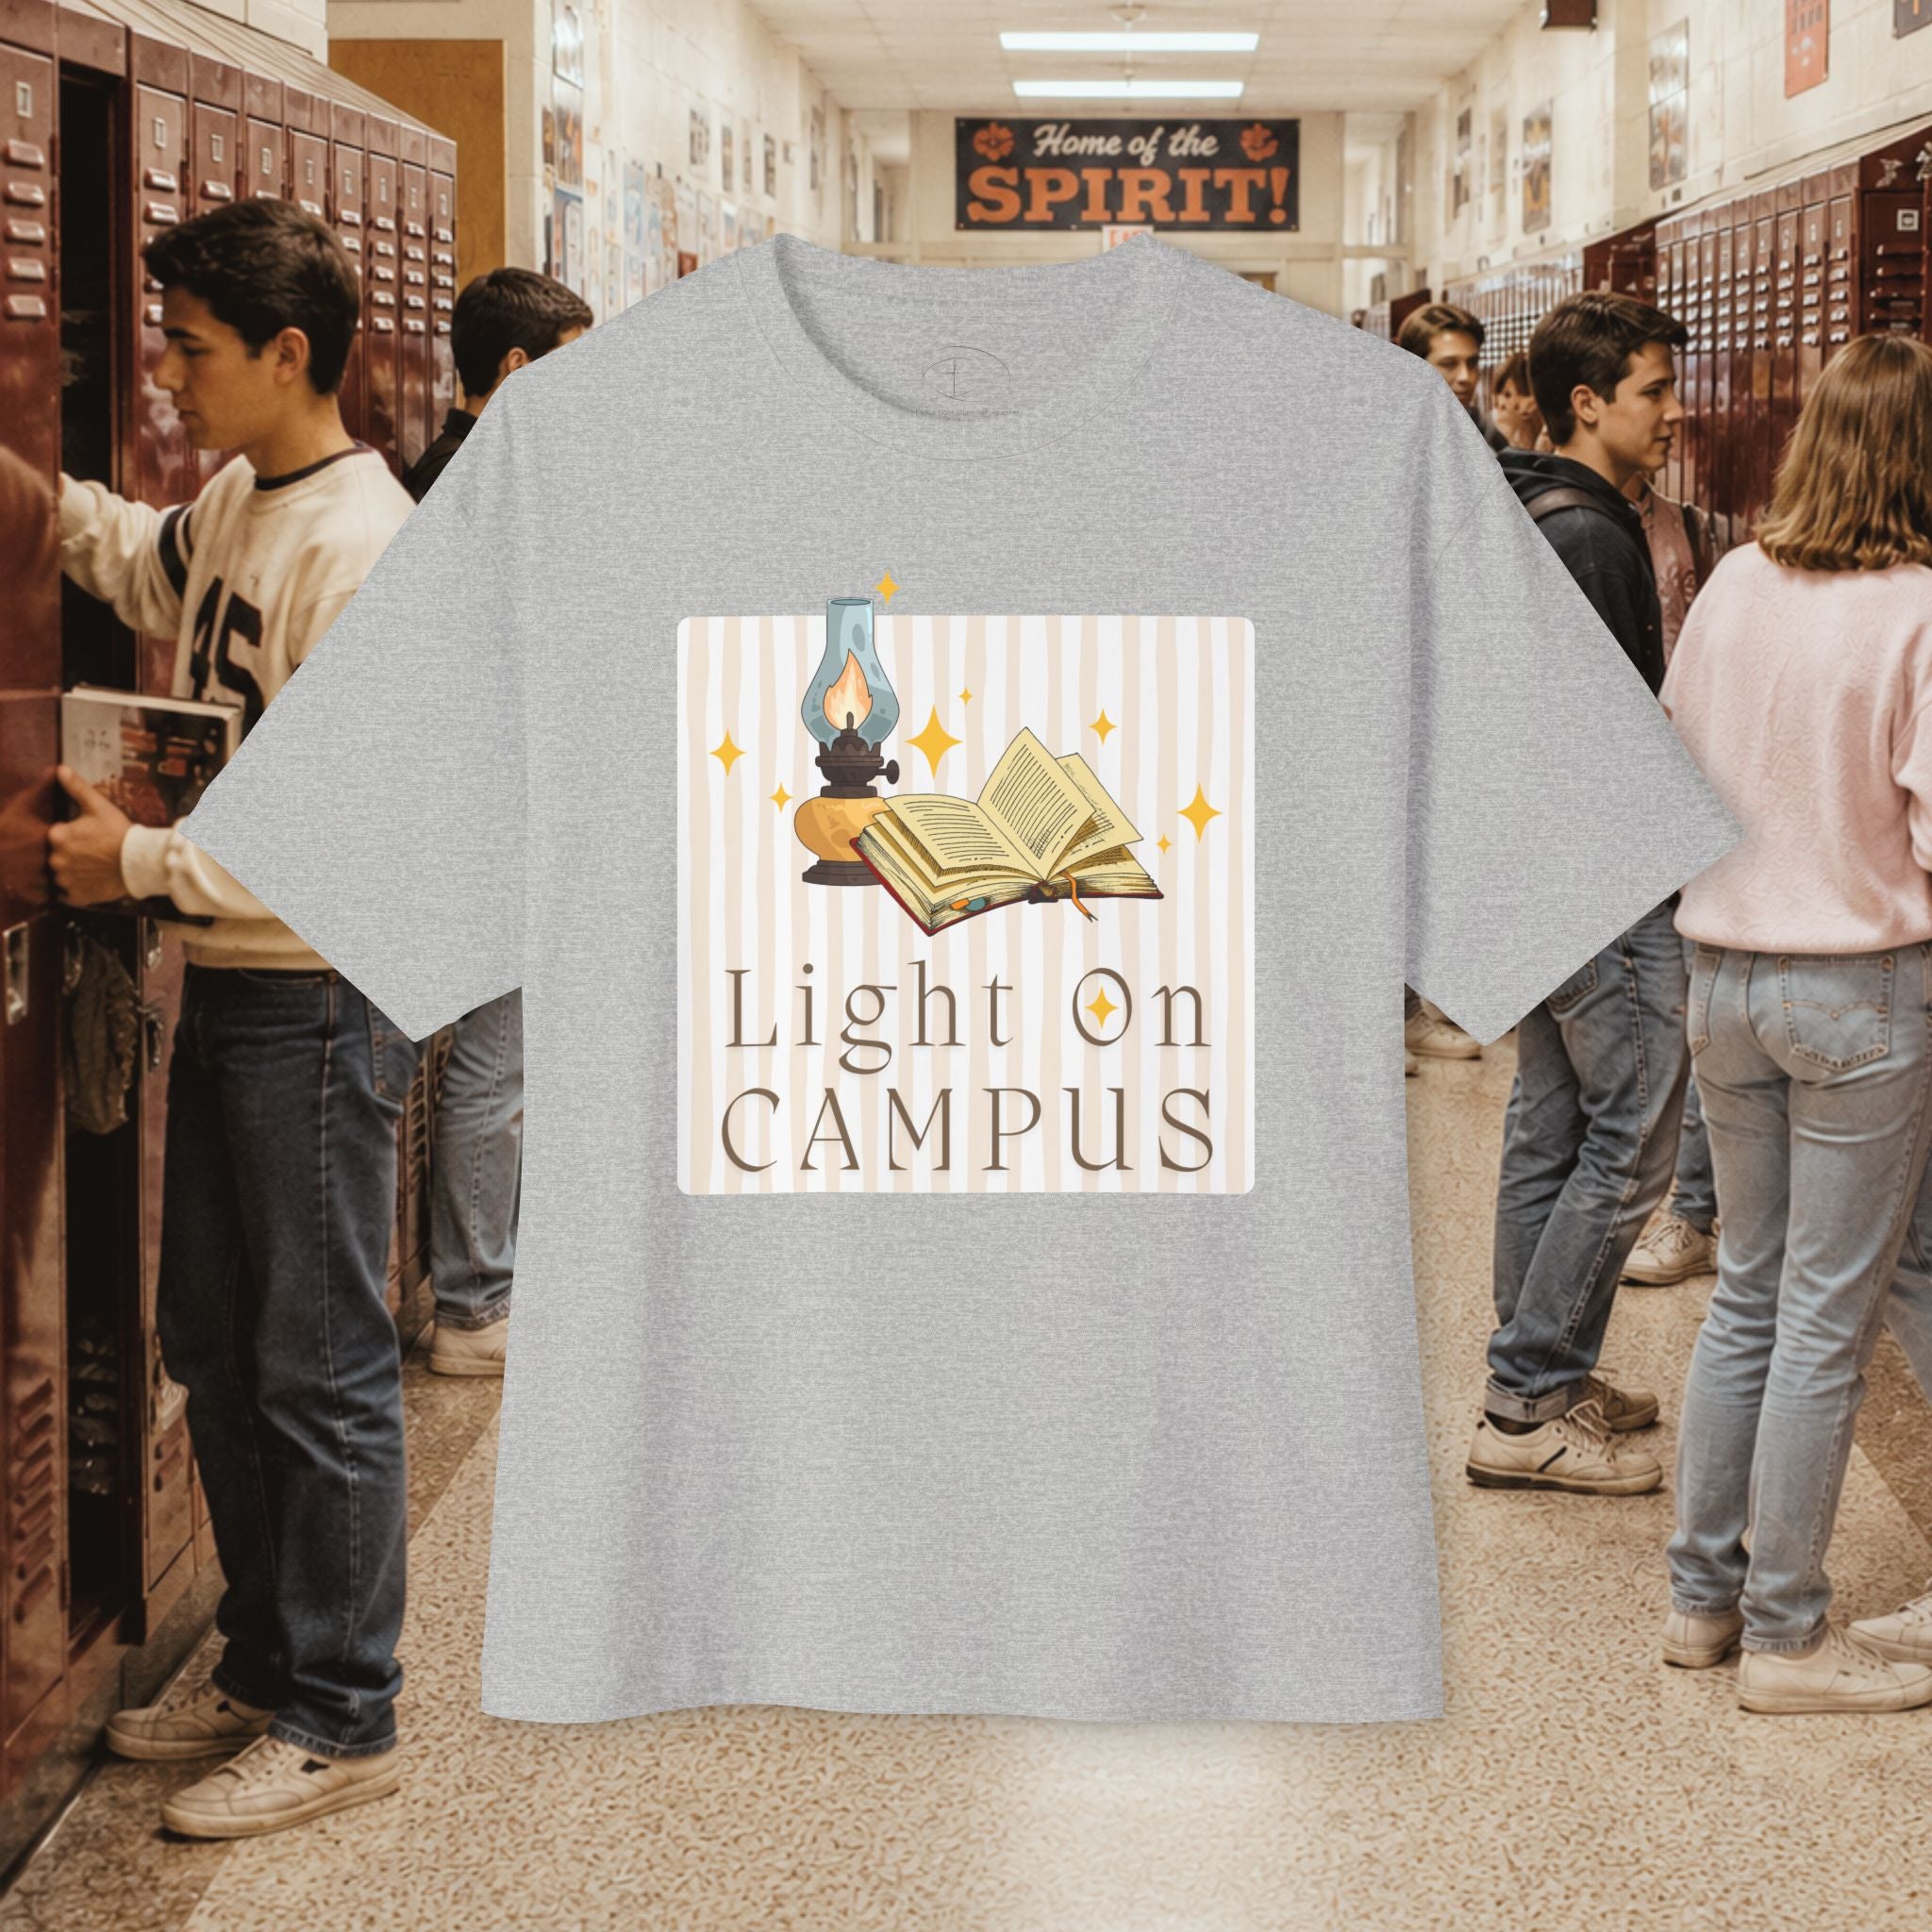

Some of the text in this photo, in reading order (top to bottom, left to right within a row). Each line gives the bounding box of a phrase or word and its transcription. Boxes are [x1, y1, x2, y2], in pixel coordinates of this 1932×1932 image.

[1033, 123, 1220, 167] Home of the
[966, 165, 1290, 225] SPIRIT!
[724, 959, 1212, 1074] Light On
[721, 1087, 1214, 1173] CAMPUS
